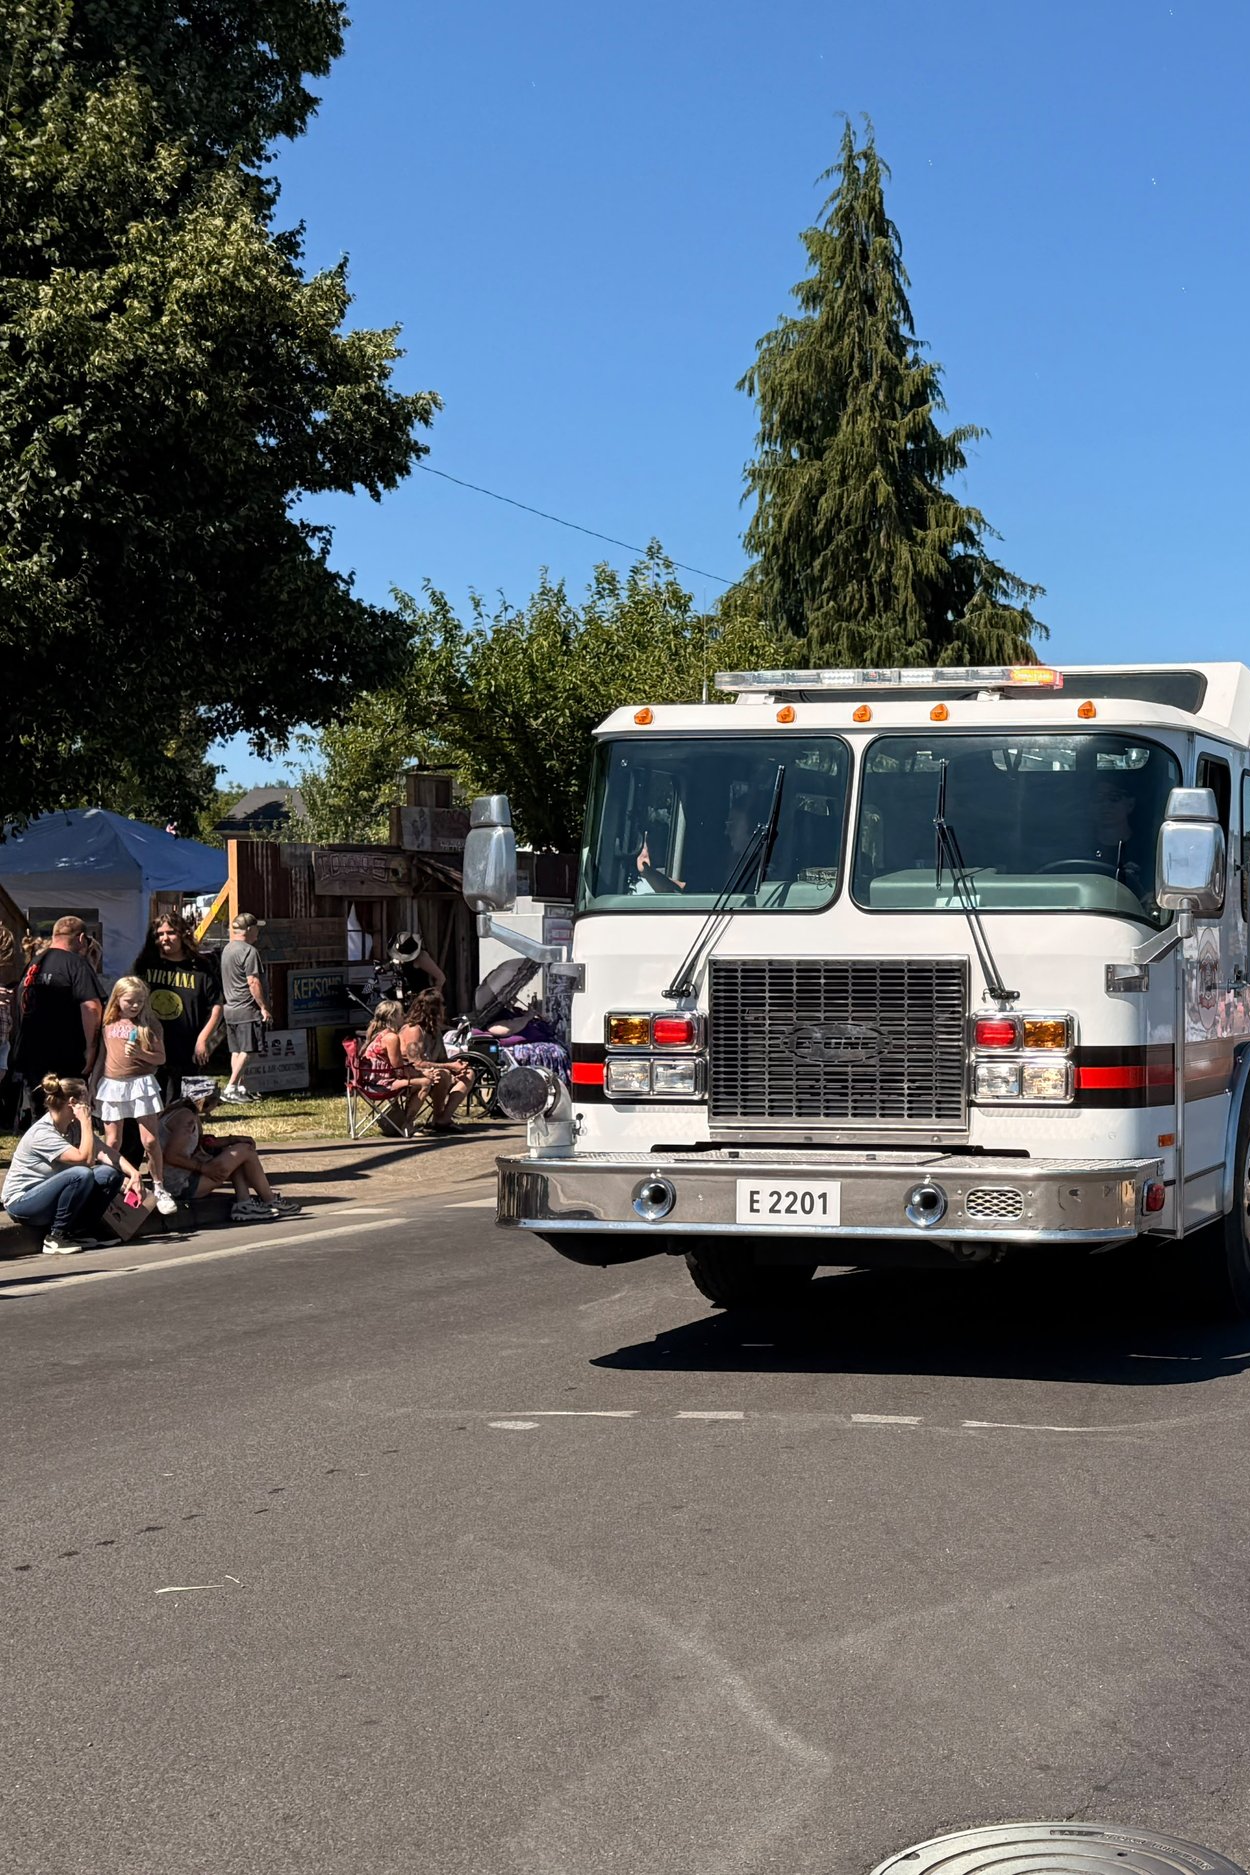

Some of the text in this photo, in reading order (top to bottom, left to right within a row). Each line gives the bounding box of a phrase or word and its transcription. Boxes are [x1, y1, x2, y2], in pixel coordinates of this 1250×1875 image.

[146, 968, 195, 989] NIRVANA
[749, 1190, 827, 1215] E 2201
